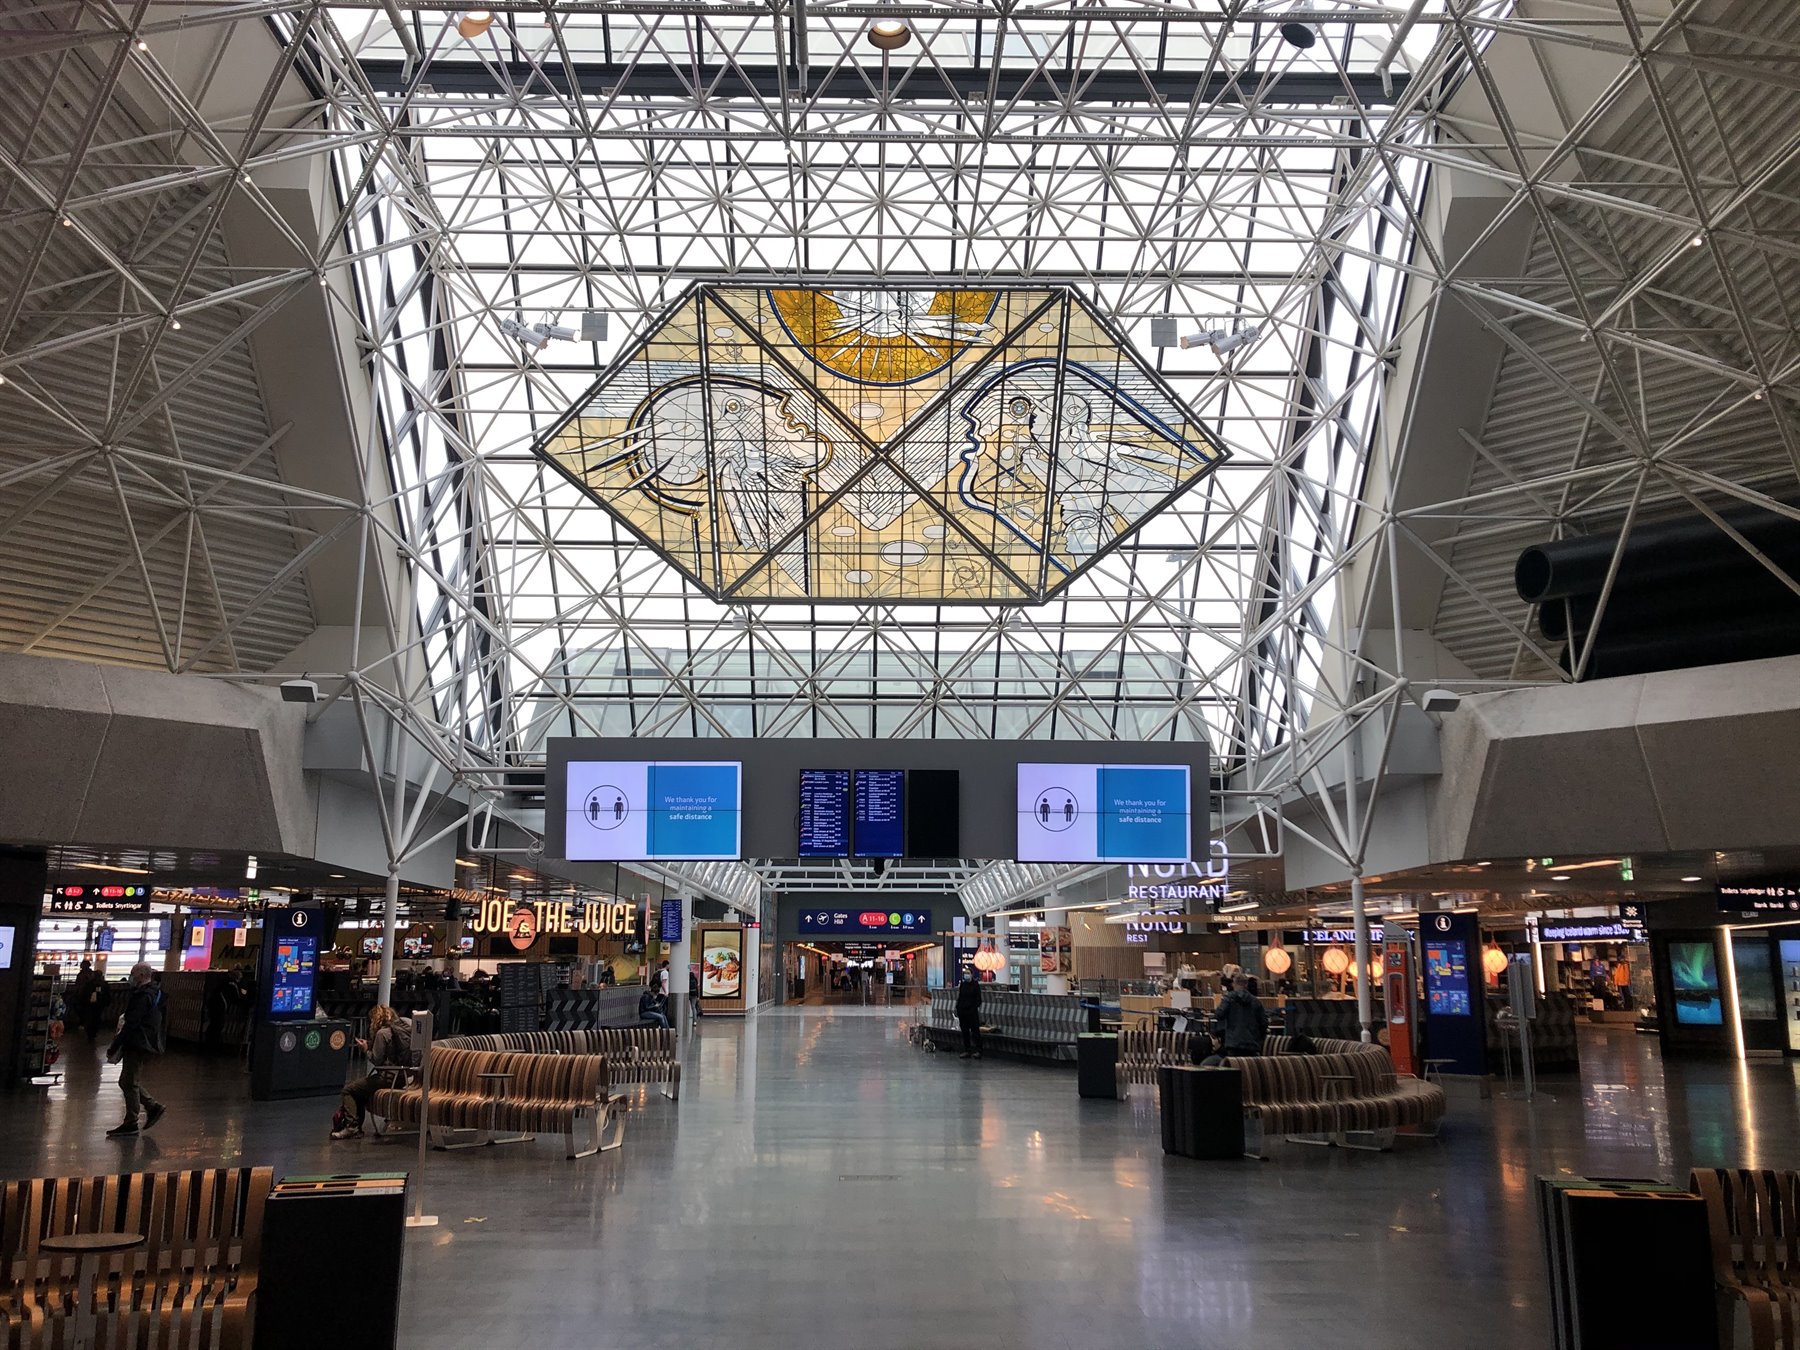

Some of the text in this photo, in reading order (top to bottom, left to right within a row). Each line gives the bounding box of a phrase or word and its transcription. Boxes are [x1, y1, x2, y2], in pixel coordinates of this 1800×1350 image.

[1143, 800, 1156, 808] you
[669, 804, 707, 813] maintaining
[1119, 808, 1157, 816] maintaining
[1128, 885, 1229, 899] RESTAURANT
[114, 902, 143, 910] Snyrtingar
[473, 901, 515, 933] JOE
[534, 902, 573, 932] THE
[579, 903, 637, 934] JUICE
